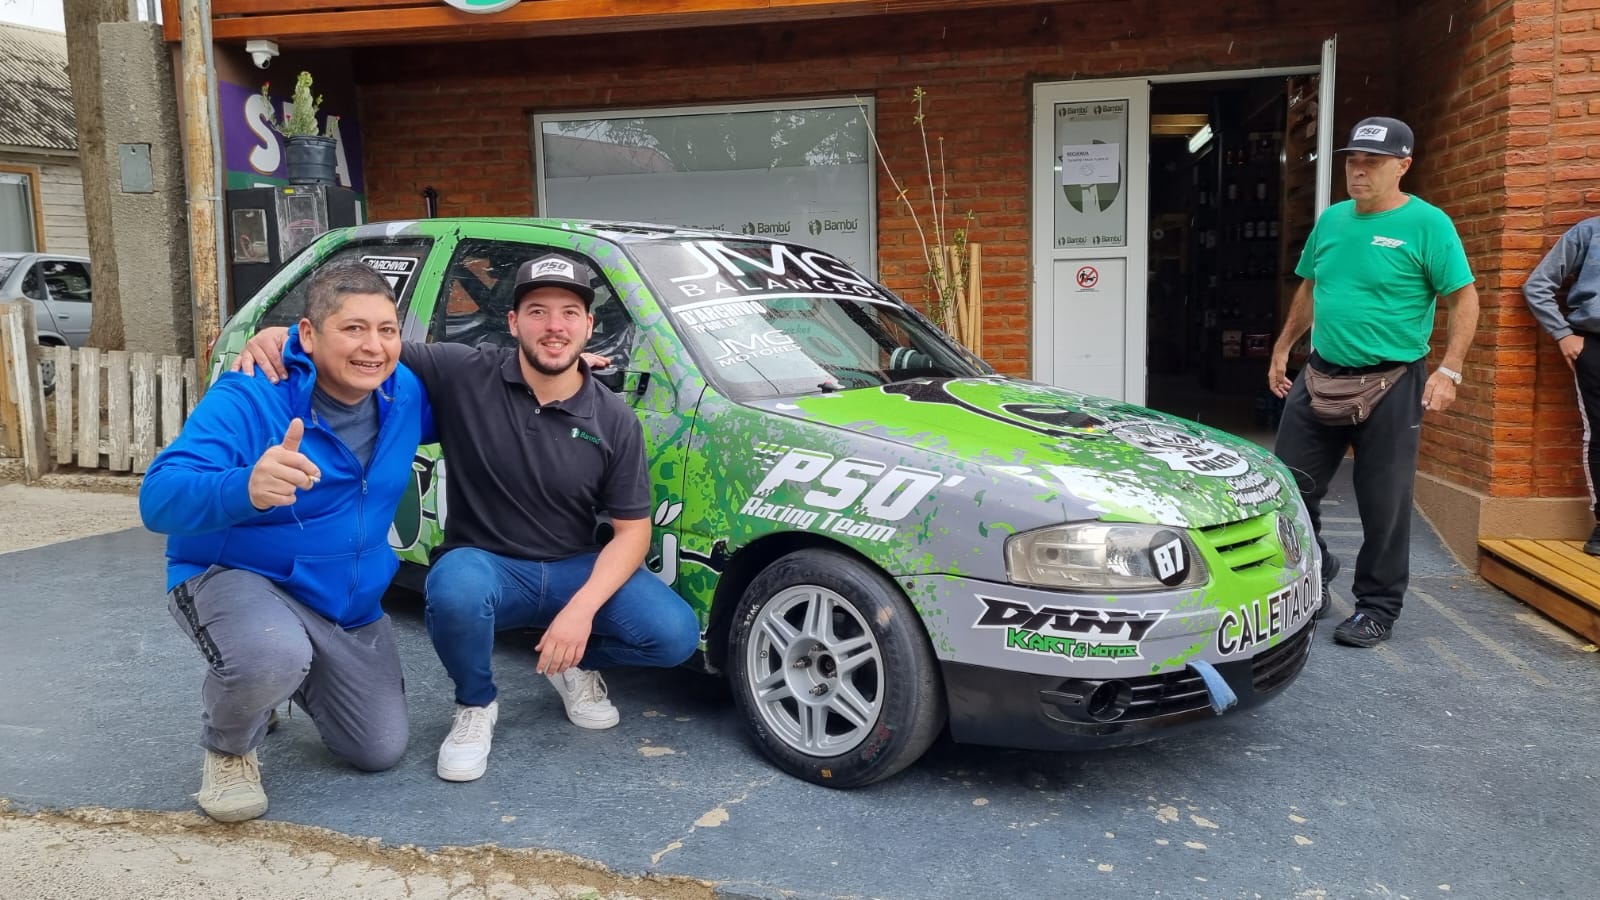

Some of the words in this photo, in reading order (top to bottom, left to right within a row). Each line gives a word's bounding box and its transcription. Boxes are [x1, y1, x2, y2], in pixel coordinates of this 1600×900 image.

[245, 93, 352, 188] SA
[757, 220, 791, 233] Bambú
[824, 218, 858, 231] Bambú
[670, 240, 875, 289] JMG
[678, 277, 889, 301] BALANCEOS
[678, 300, 768, 326] D'ARCHIVIO
[714, 329, 795, 360] JMG
[718, 343, 802, 368] MOTORES
[740, 496, 820, 530] Racing
[819, 511, 897, 543] Team
[1153, 537, 1185, 580] 87
[975, 596, 1165, 642] DANY
[1217, 581, 1301, 656] CALETA
[1006, 626, 1077, 655] KART
[1073, 642, 1087, 658] &
[1088, 643, 1138, 658] MOTOS
